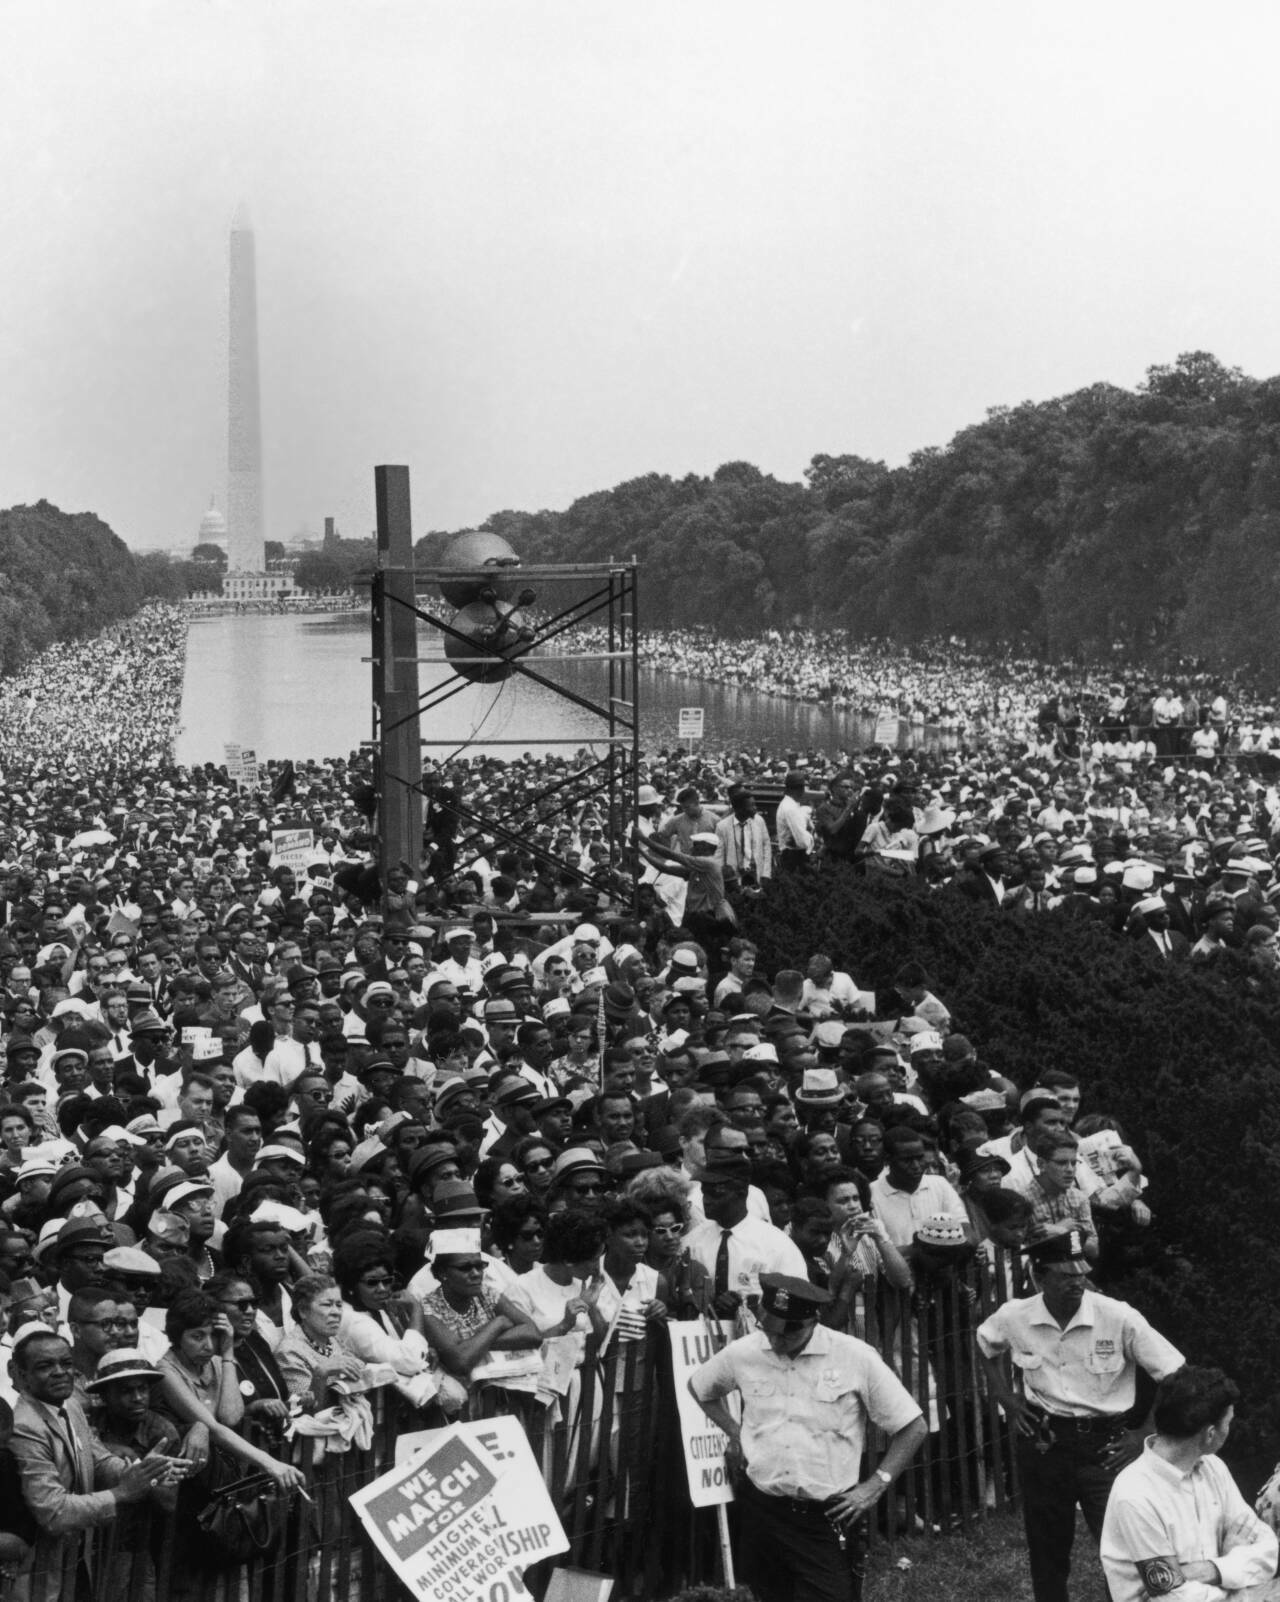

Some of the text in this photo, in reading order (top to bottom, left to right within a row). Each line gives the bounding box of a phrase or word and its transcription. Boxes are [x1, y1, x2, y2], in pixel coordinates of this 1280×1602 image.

[386, 1460, 481, 1543] MARCH
[398, 1468, 438, 1501] WE
[426, 1506, 484, 1561] HIGHE
[427, 1500, 467, 1534] FOR
[416, 1534, 482, 1592] MINIMUM
[433, 1539, 500, 1601] COVERAG
[472, 1555, 508, 1586] WOR
